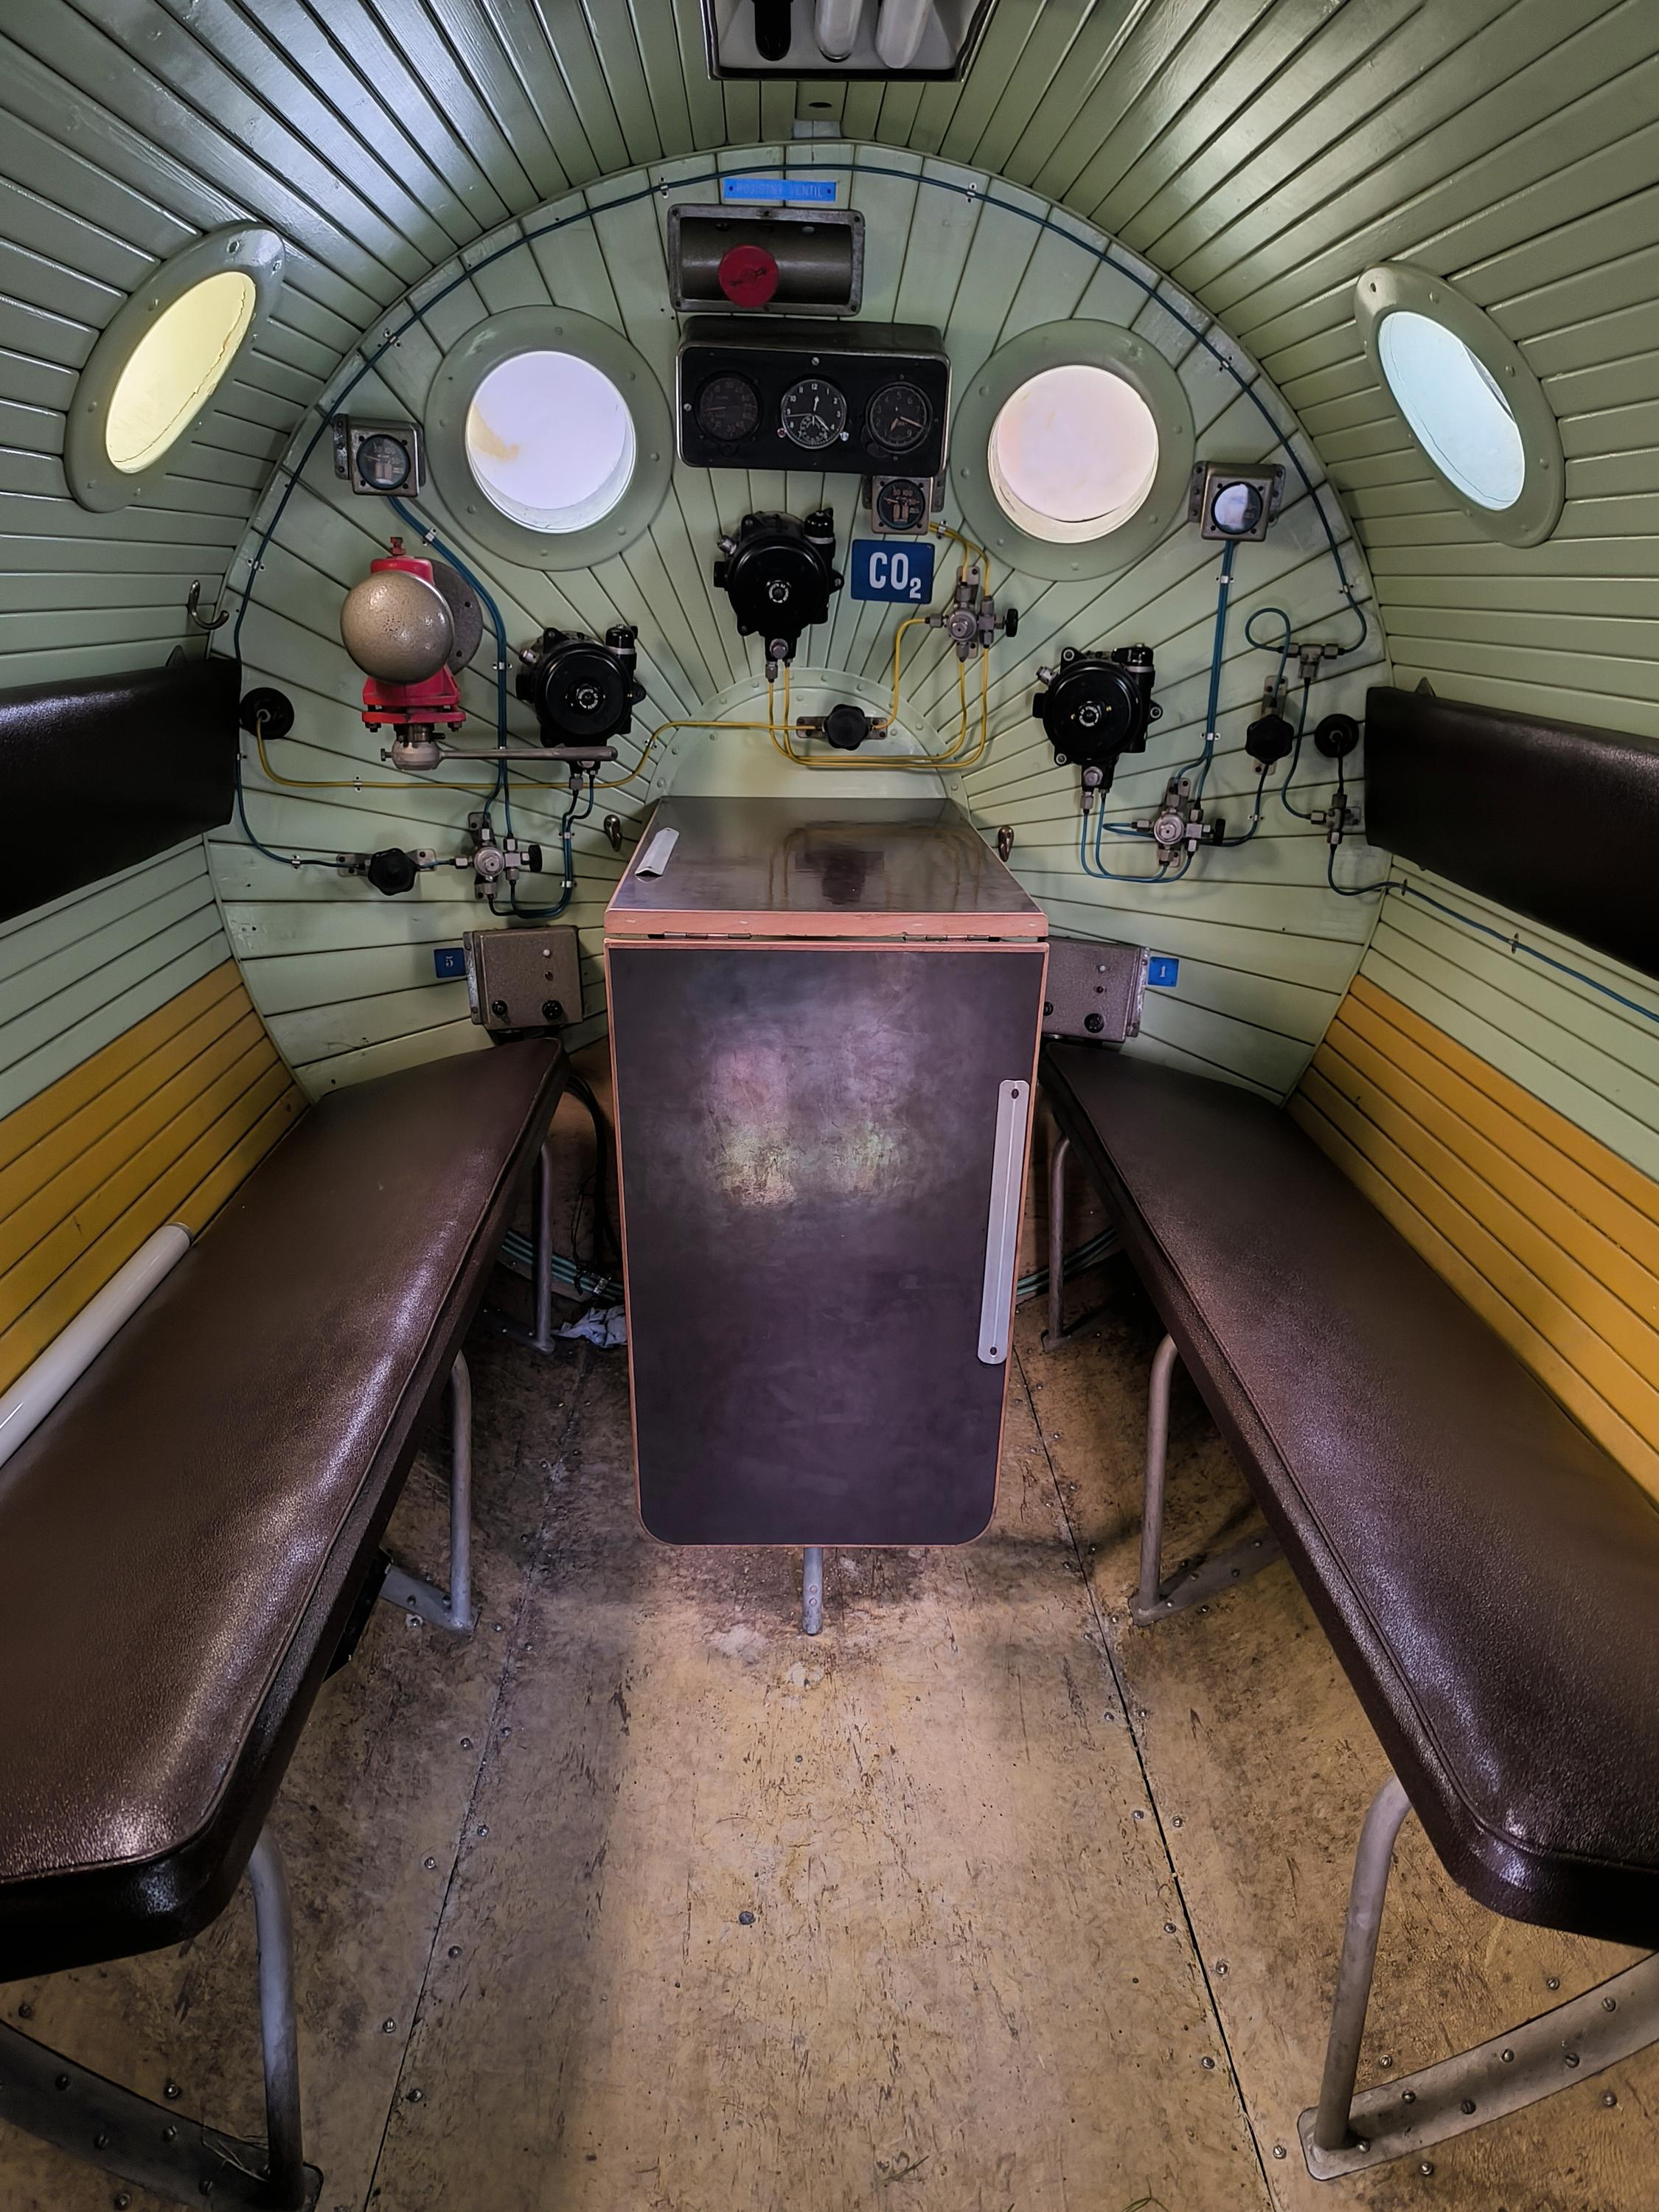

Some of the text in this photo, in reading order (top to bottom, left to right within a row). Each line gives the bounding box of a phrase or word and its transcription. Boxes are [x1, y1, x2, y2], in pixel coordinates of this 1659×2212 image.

[897, 391, 902, 400] 5
[907, 429, 912, 437] 9
[445, 956, 453, 967] 5
[1160, 966, 1165, 978] 1
